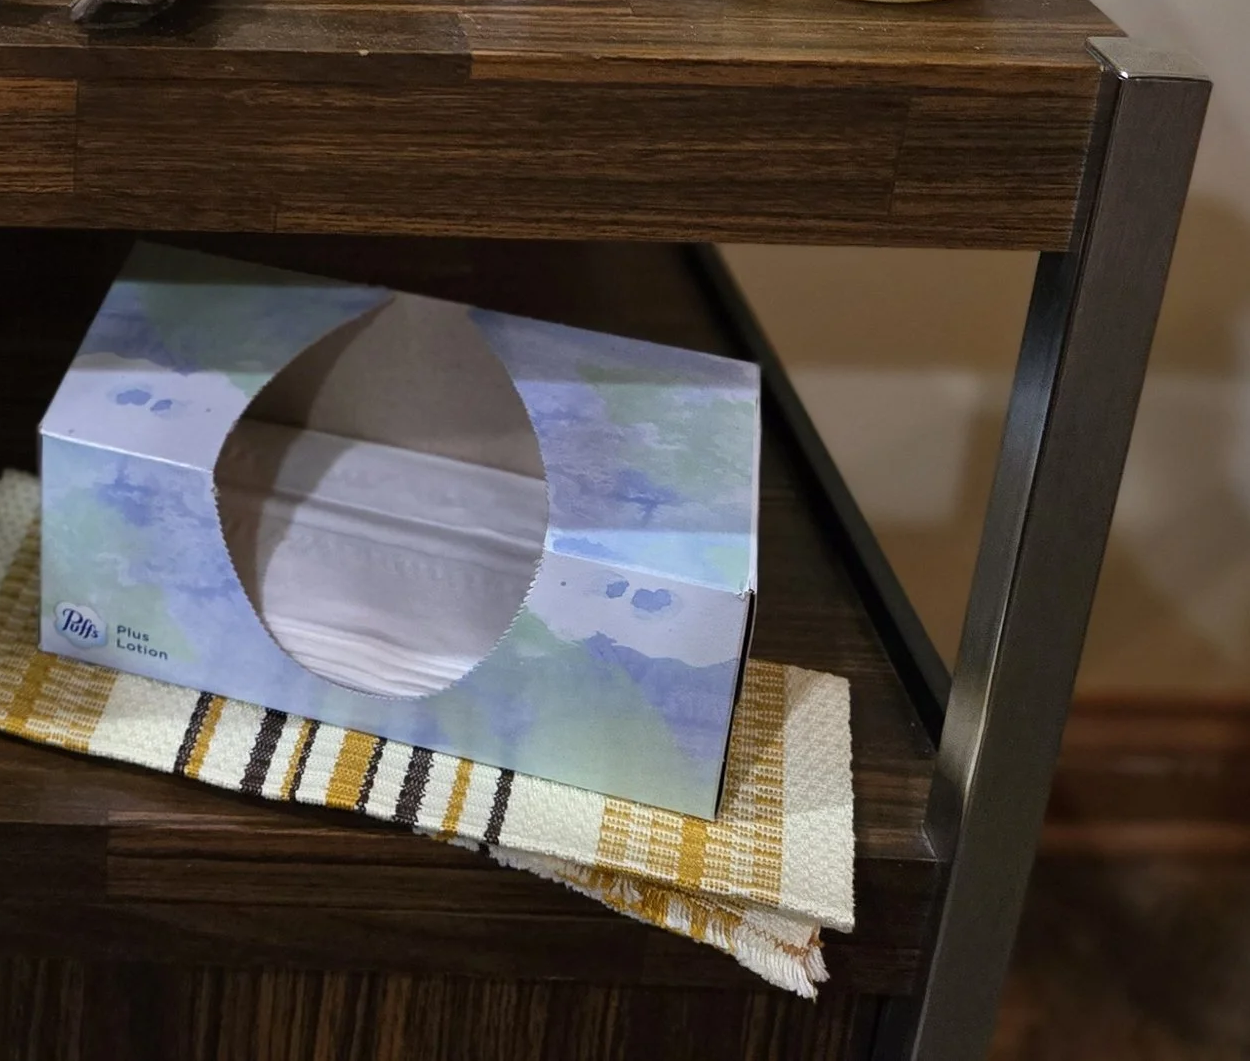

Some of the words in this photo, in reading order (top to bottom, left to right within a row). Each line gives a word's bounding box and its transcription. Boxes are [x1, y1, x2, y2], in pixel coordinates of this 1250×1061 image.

[62, 607, 100, 639] Puffs
[117, 625, 150, 641] Plus
[117, 639, 168, 660] Lotion
